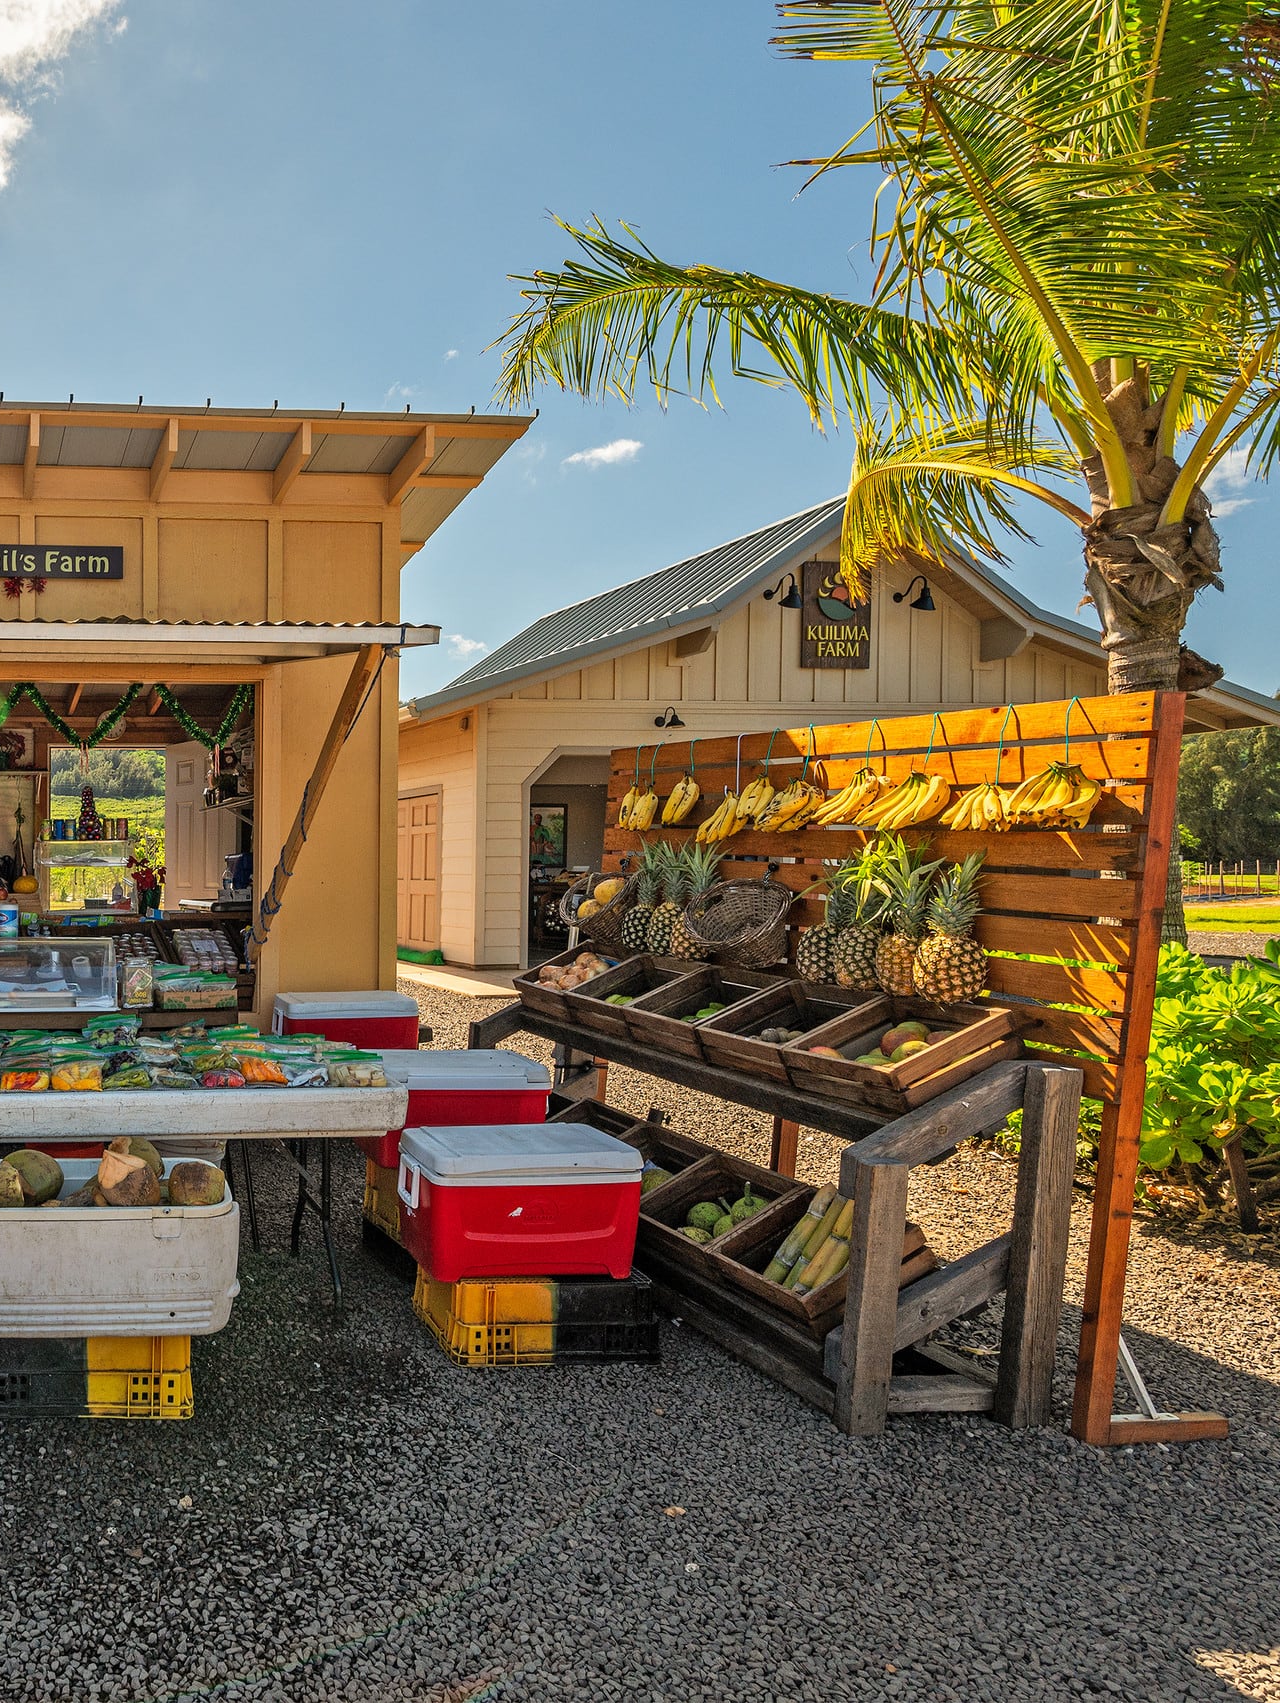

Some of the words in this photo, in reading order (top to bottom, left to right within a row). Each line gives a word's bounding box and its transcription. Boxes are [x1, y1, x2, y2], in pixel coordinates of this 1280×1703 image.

[45, 551, 110, 573] Farm
[807, 625, 869, 641] KUILIMA
[817, 641, 860, 657] FARM
